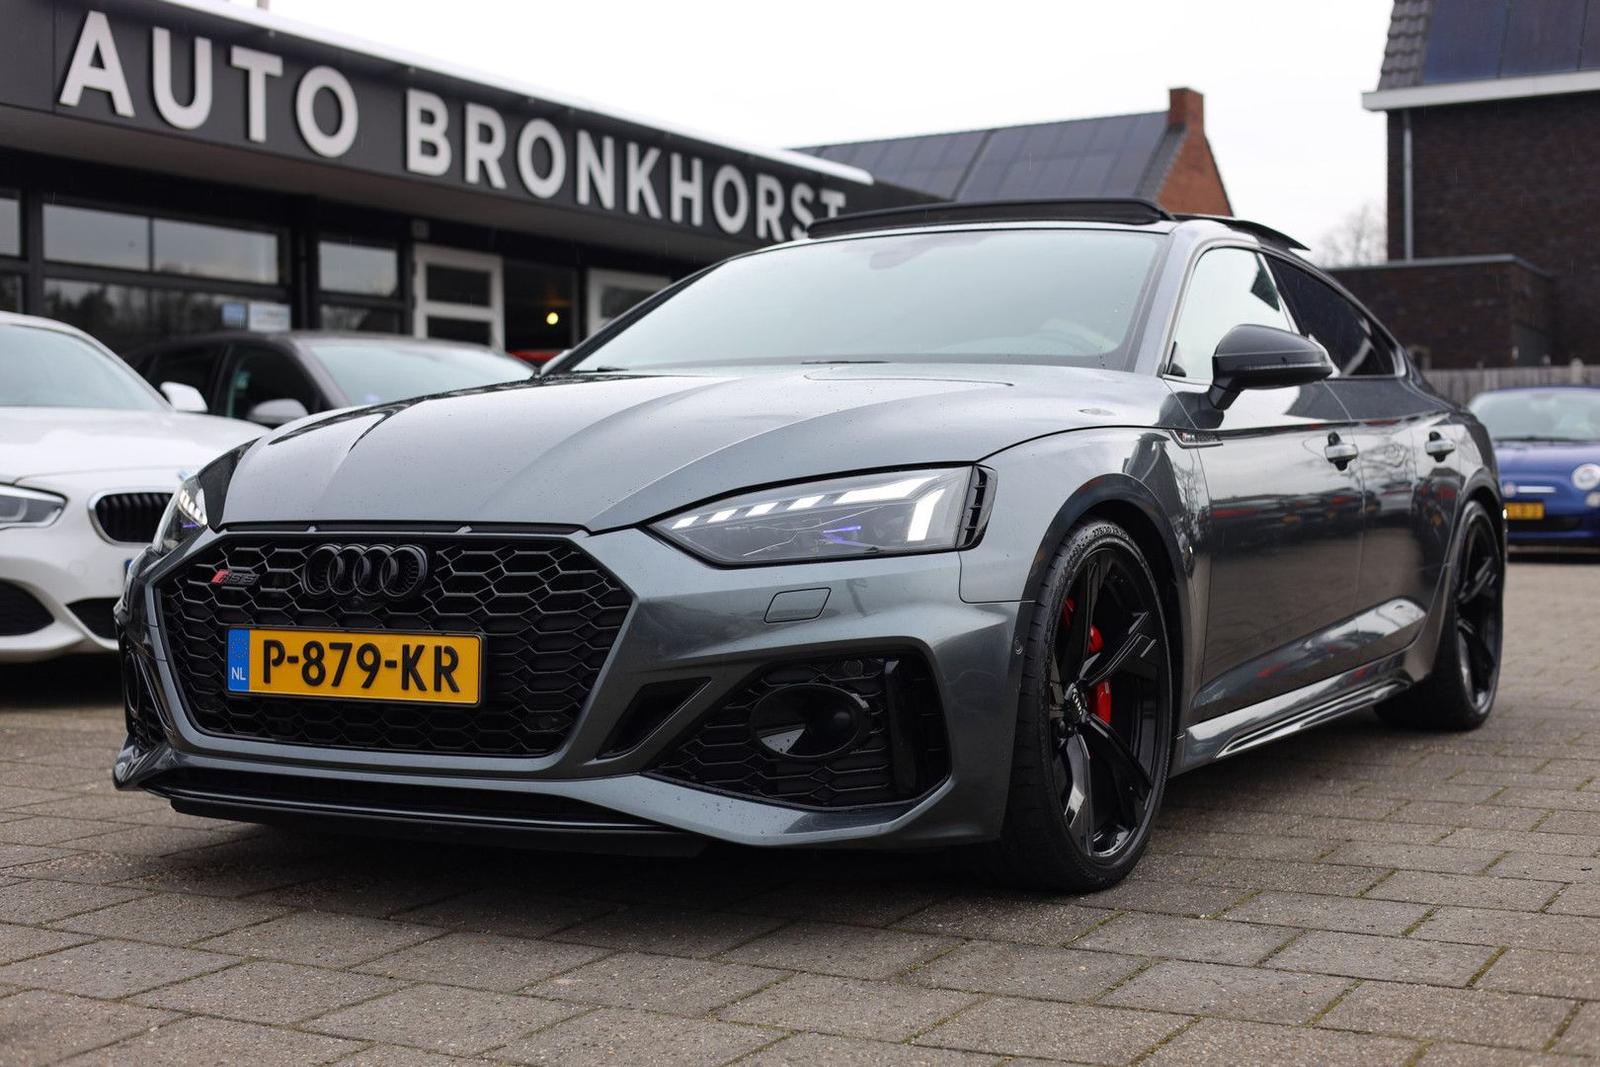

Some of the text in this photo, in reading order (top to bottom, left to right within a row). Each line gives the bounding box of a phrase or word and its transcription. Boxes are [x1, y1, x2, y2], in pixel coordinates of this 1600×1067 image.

[59, 10, 846, 242] AUTO BRONKHORST
[231, 639, 460, 693] NL P-879-KR
